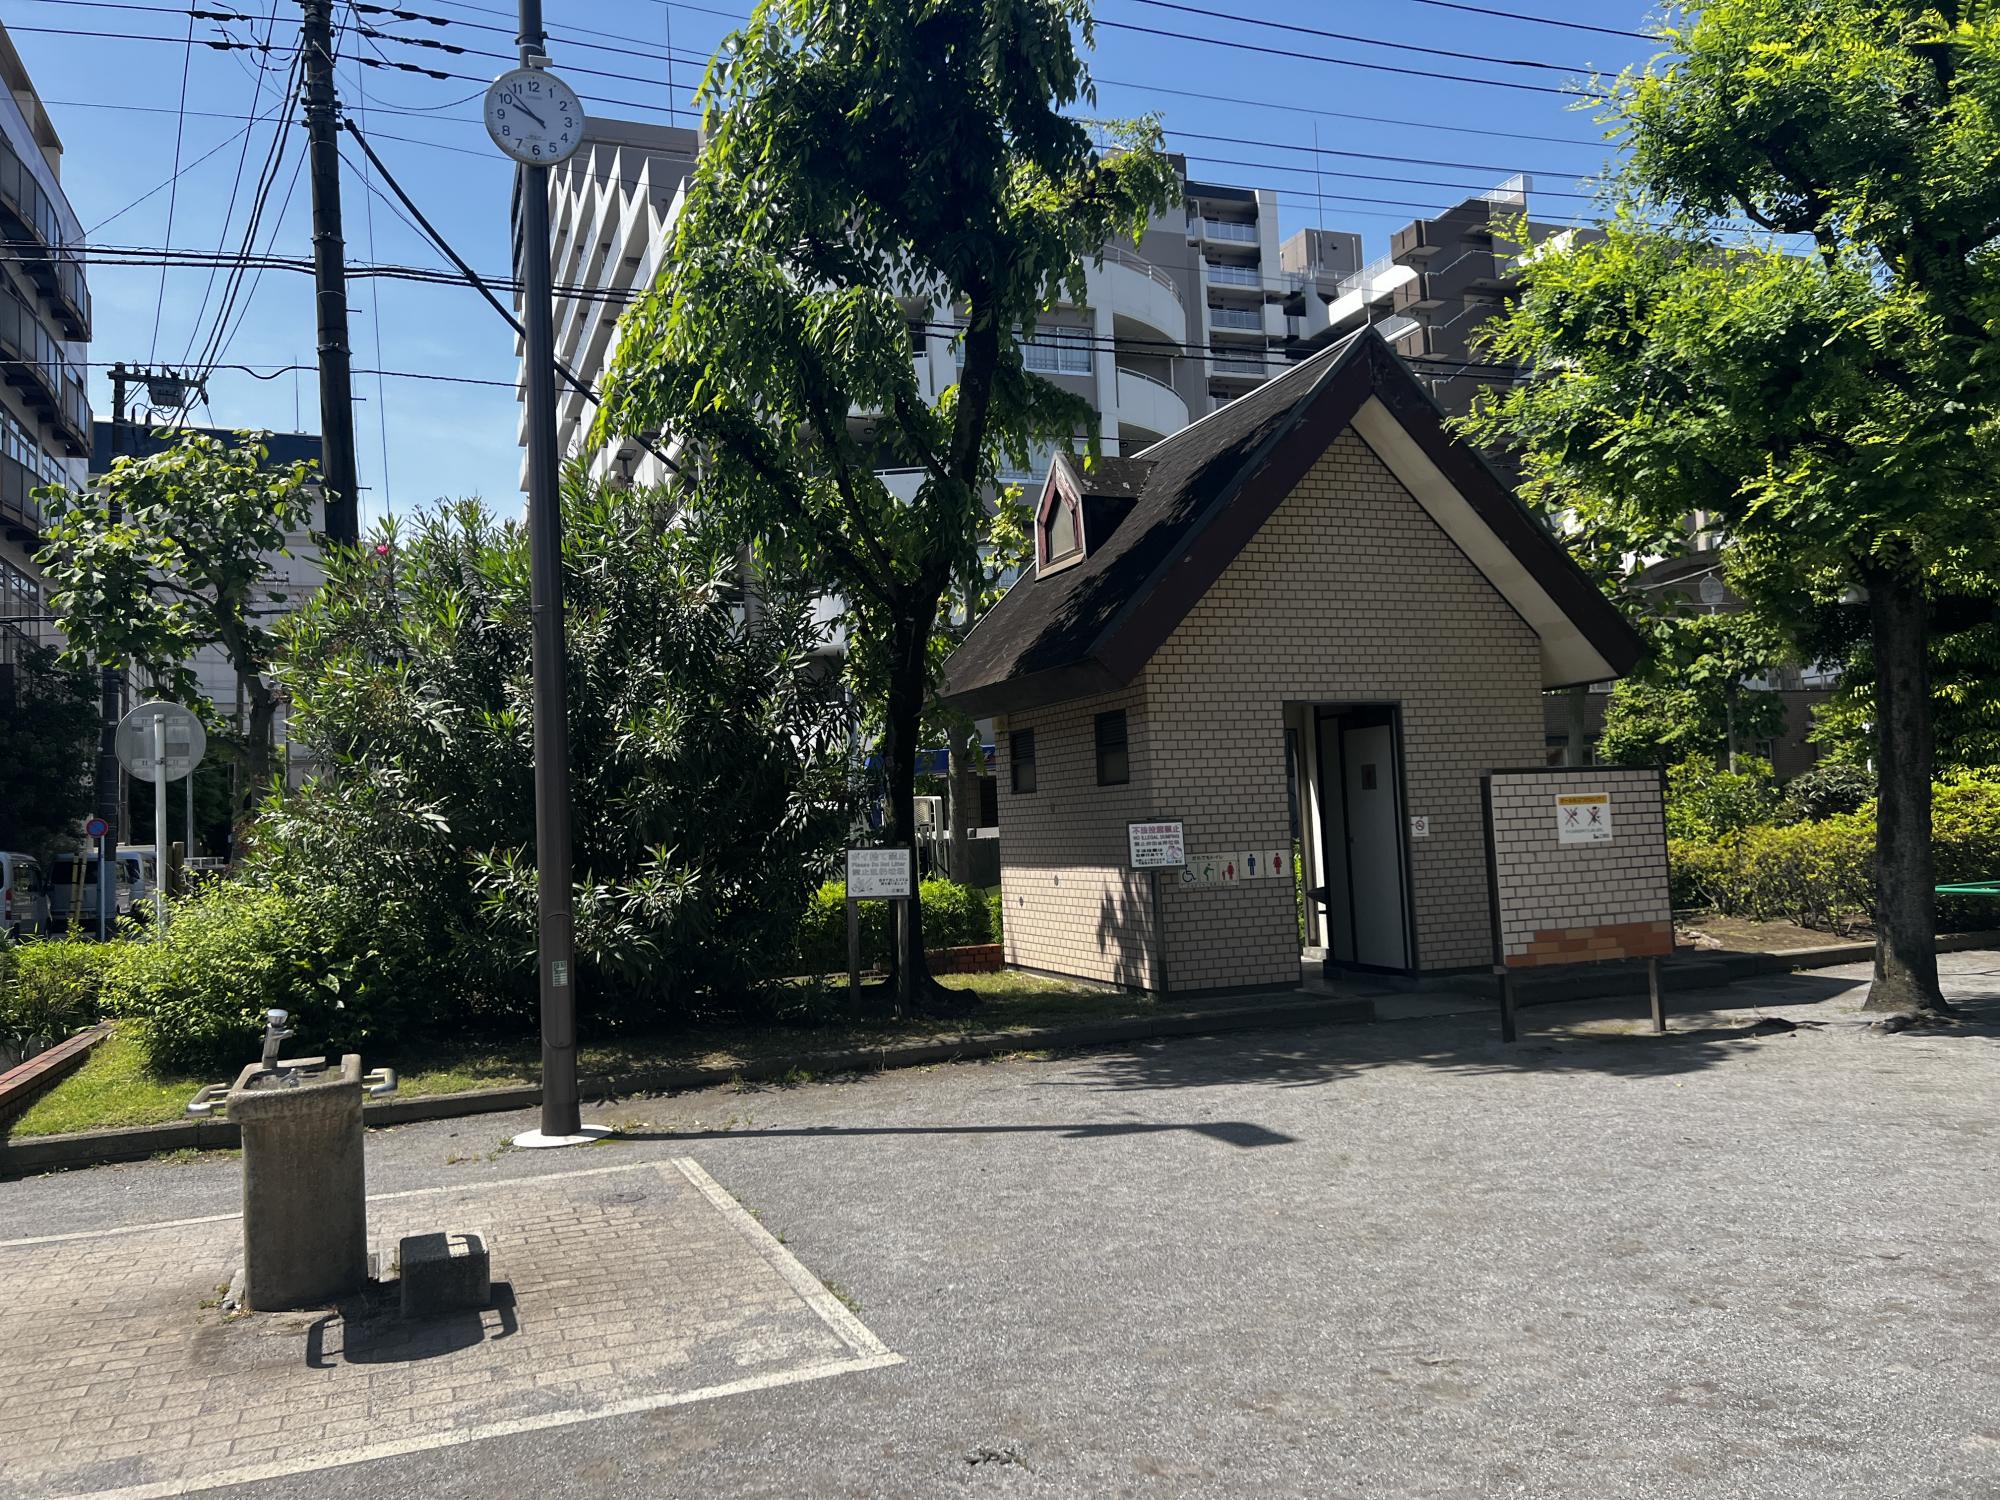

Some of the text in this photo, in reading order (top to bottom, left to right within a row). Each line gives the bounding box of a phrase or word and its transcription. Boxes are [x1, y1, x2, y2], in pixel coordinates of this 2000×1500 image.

[512, 83, 522, 94] 11
[527, 81, 540, 93] 12
[499, 93, 512, 105] 10
[559, 100, 568, 112] 2
[497, 108, 506, 120] 9
[564, 117, 573, 128] 3
[502, 125, 511, 136] 8
[560, 132, 569, 143] 4
[515, 138, 523, 149] 7
[548, 142, 558, 153] 5
[531, 144, 541, 156] 6
